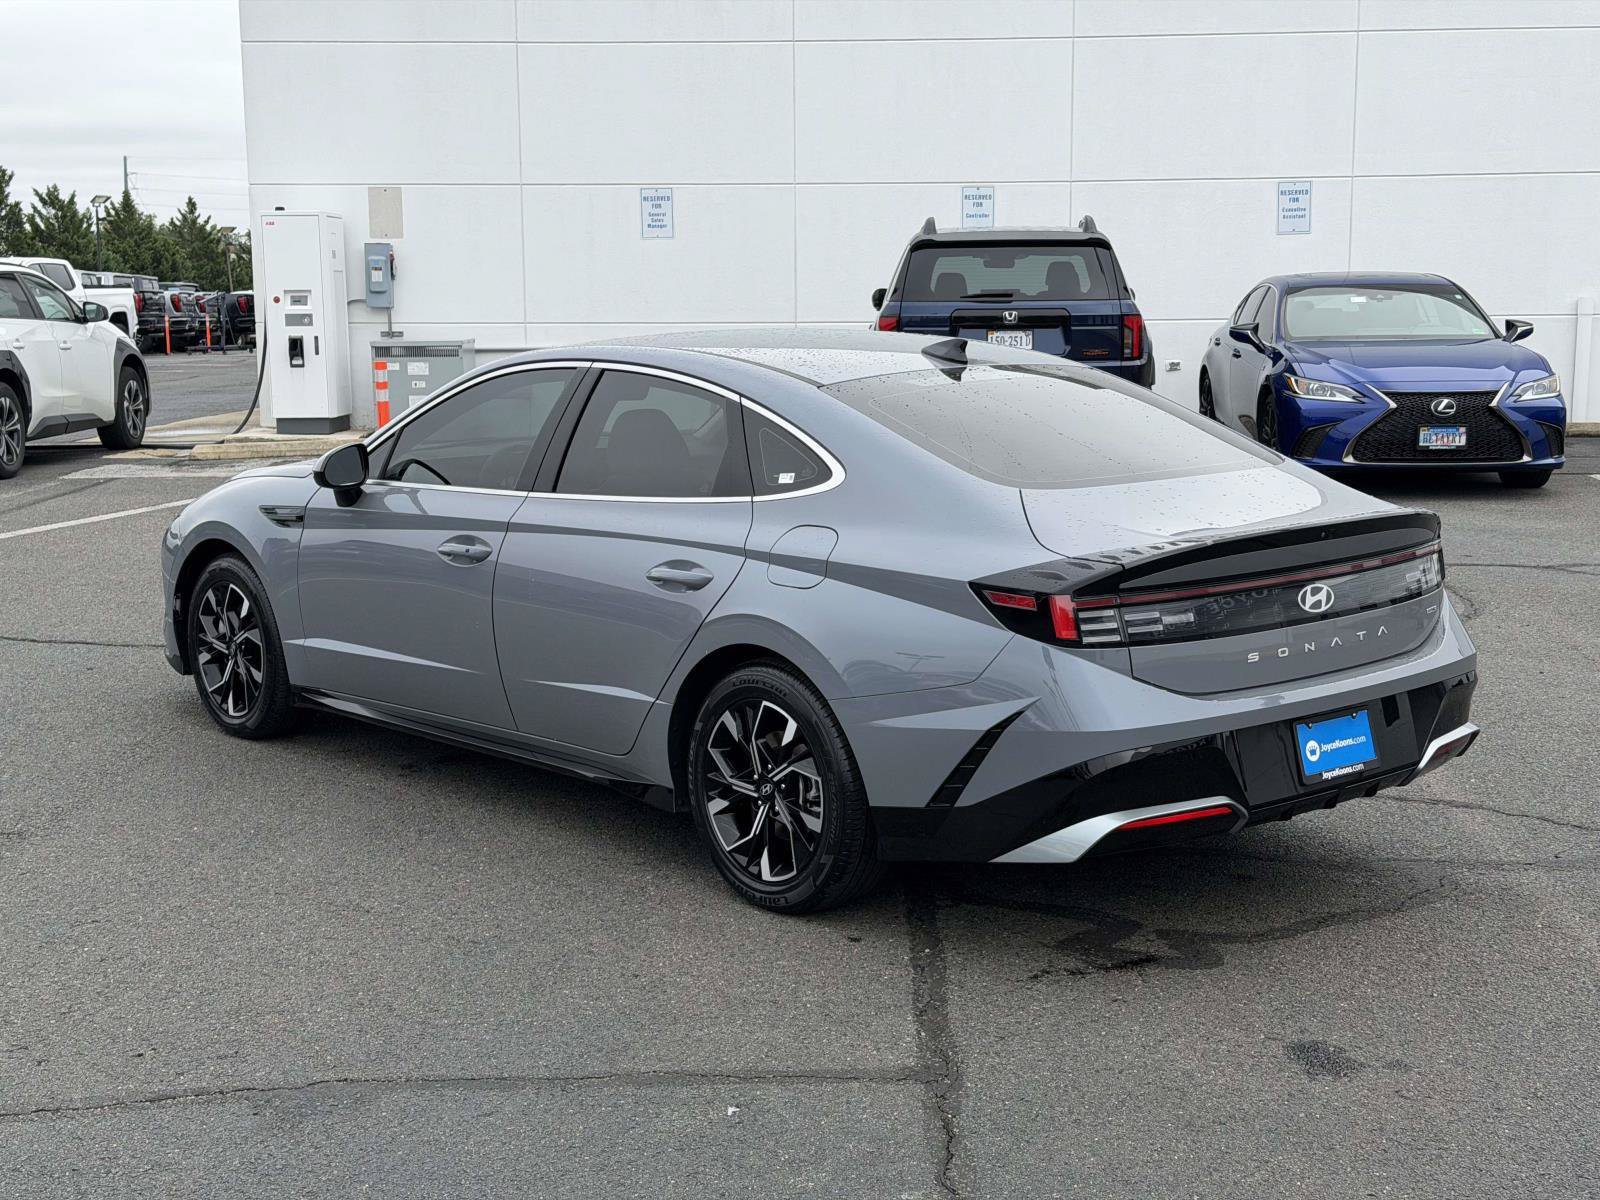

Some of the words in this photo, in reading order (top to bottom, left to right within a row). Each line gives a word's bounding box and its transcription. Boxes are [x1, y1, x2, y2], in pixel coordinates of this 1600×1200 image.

[964, 193, 992, 201] RESERVED
[1247, 625, 1388, 664] SONATA
[1320, 735, 1367, 753] JoyceKoons.com
[1322, 763, 1365, 780] JoyceKoons.com
